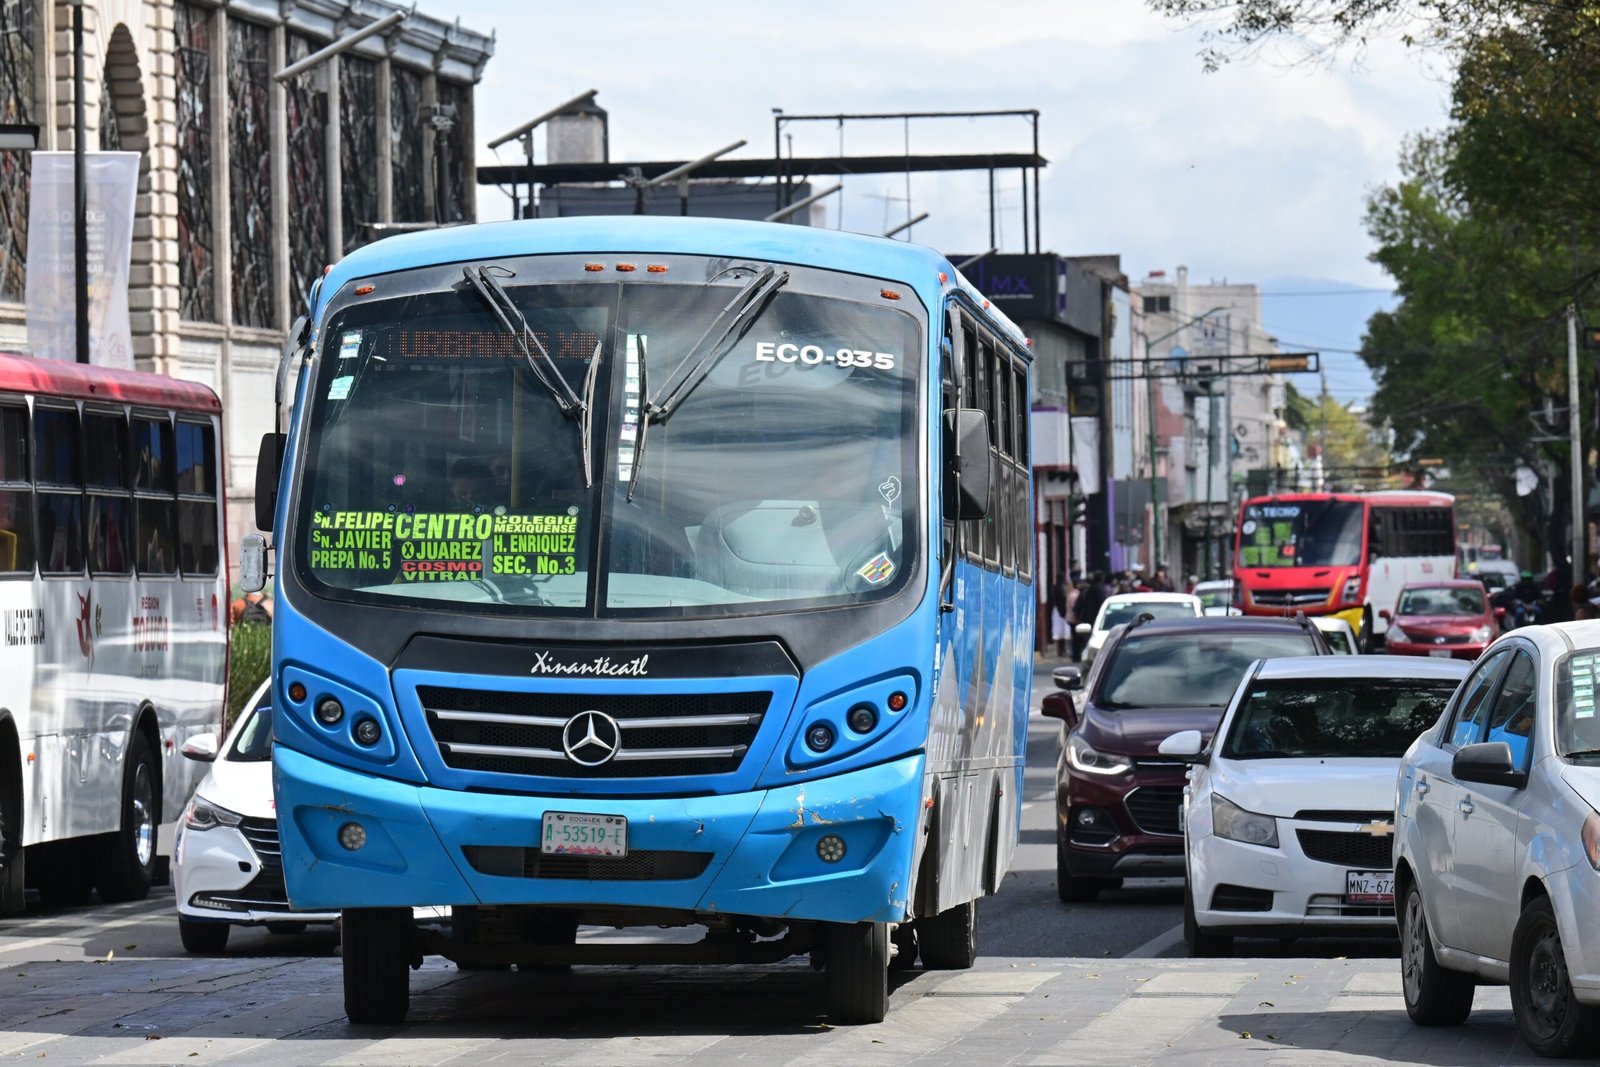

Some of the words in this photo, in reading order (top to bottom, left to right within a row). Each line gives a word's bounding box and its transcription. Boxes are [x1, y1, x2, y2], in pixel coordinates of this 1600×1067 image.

[756, 342, 894, 370] ECO-935
[335, 512, 394, 529] FELIPE
[395, 513, 492, 540] CENTRO
[494, 524, 576, 534] MEXIQUENSE
[495, 515, 577, 525] COLEGIO
[335, 531, 392, 548] JAVIER
[493, 534, 507, 553] H.
[510, 534, 575, 554] ENRIQUEZ
[311, 550, 355, 569] PREPA
[359, 551, 380, 569] No.
[382, 551, 391, 569] 5
[416, 541, 482, 560] JUAREZ
[402, 561, 482, 572] COSMO
[492, 555, 531, 574] SEC.
[402, 571, 482, 581] VITRAL
[531, 651, 648, 676] Xinantécatl
